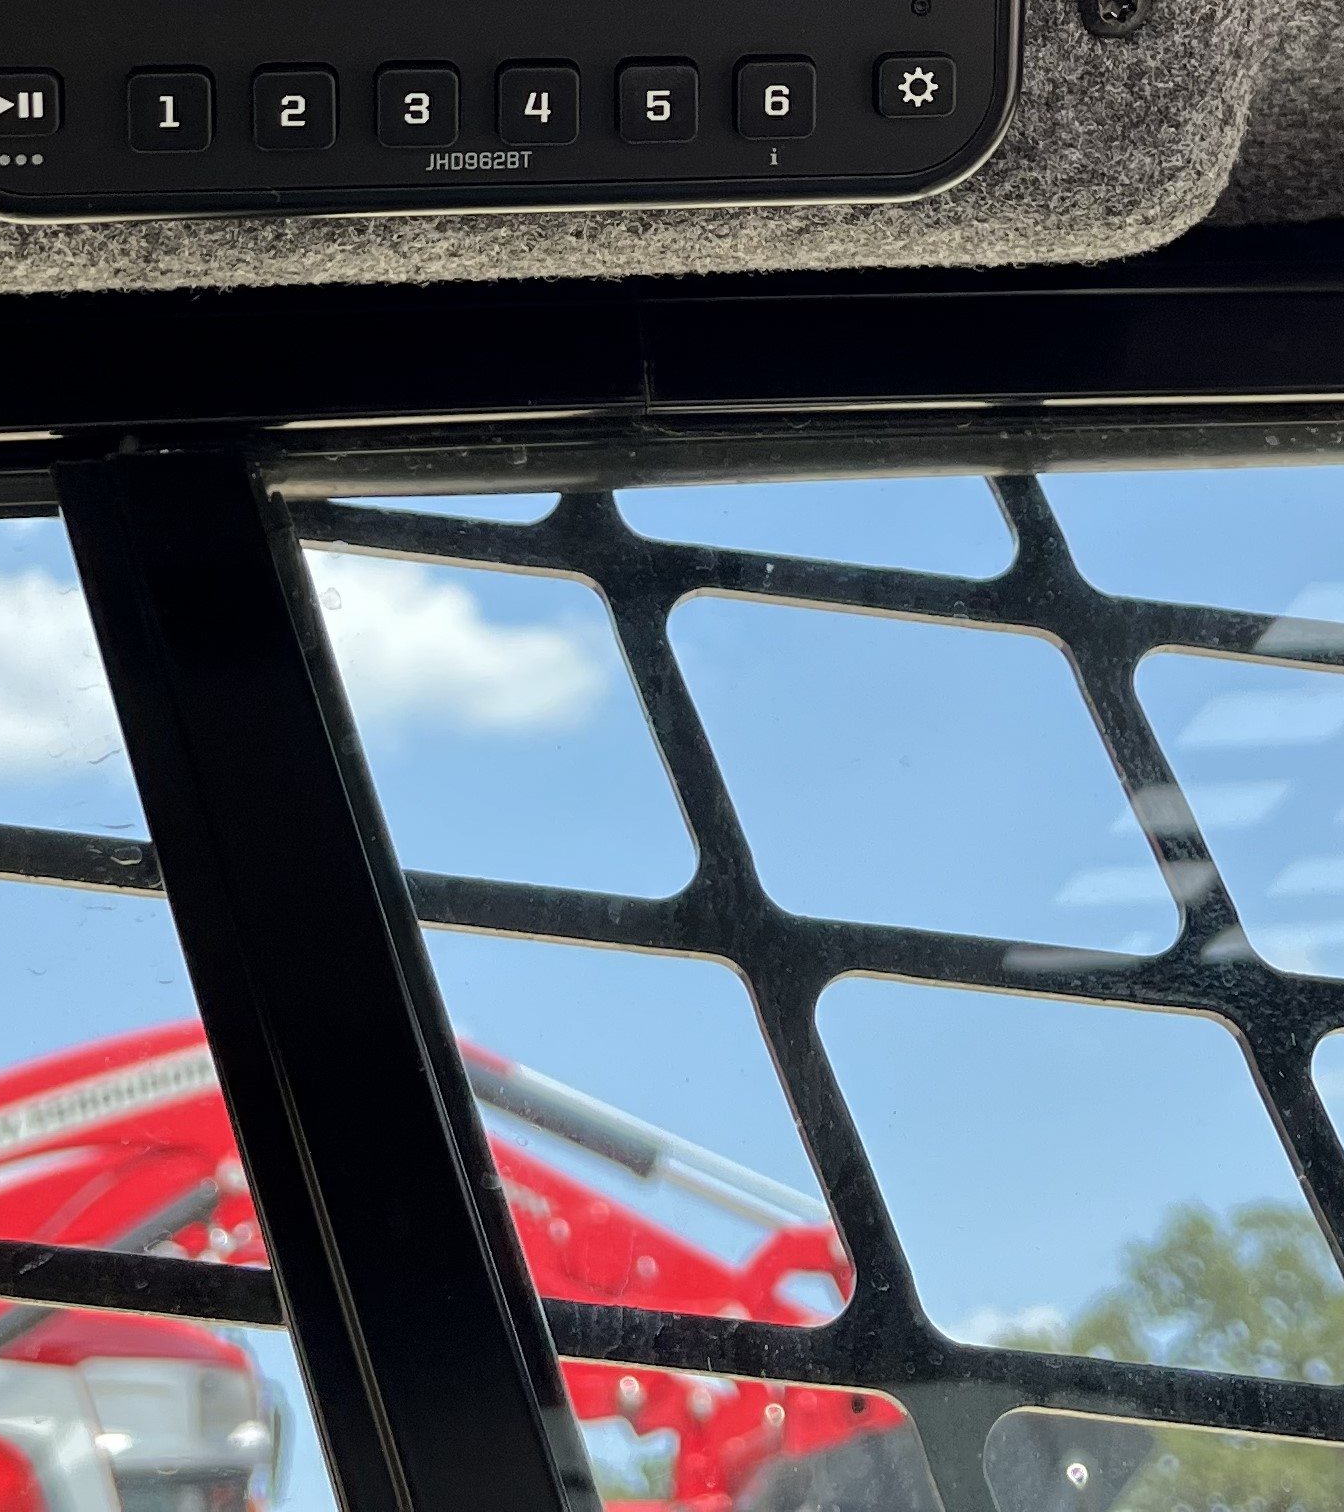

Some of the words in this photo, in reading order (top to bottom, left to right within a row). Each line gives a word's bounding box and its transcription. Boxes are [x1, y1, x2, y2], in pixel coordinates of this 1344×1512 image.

[159, 95, 180, 128] 1
[280, 94, 306, 127] 2
[403, 92, 430, 125] 3
[524, 92, 552, 123] 4
[646, 89, 671, 121] 5
[764, 84, 790, 116] 6
[425, 150, 533, 171] JHD962BT
